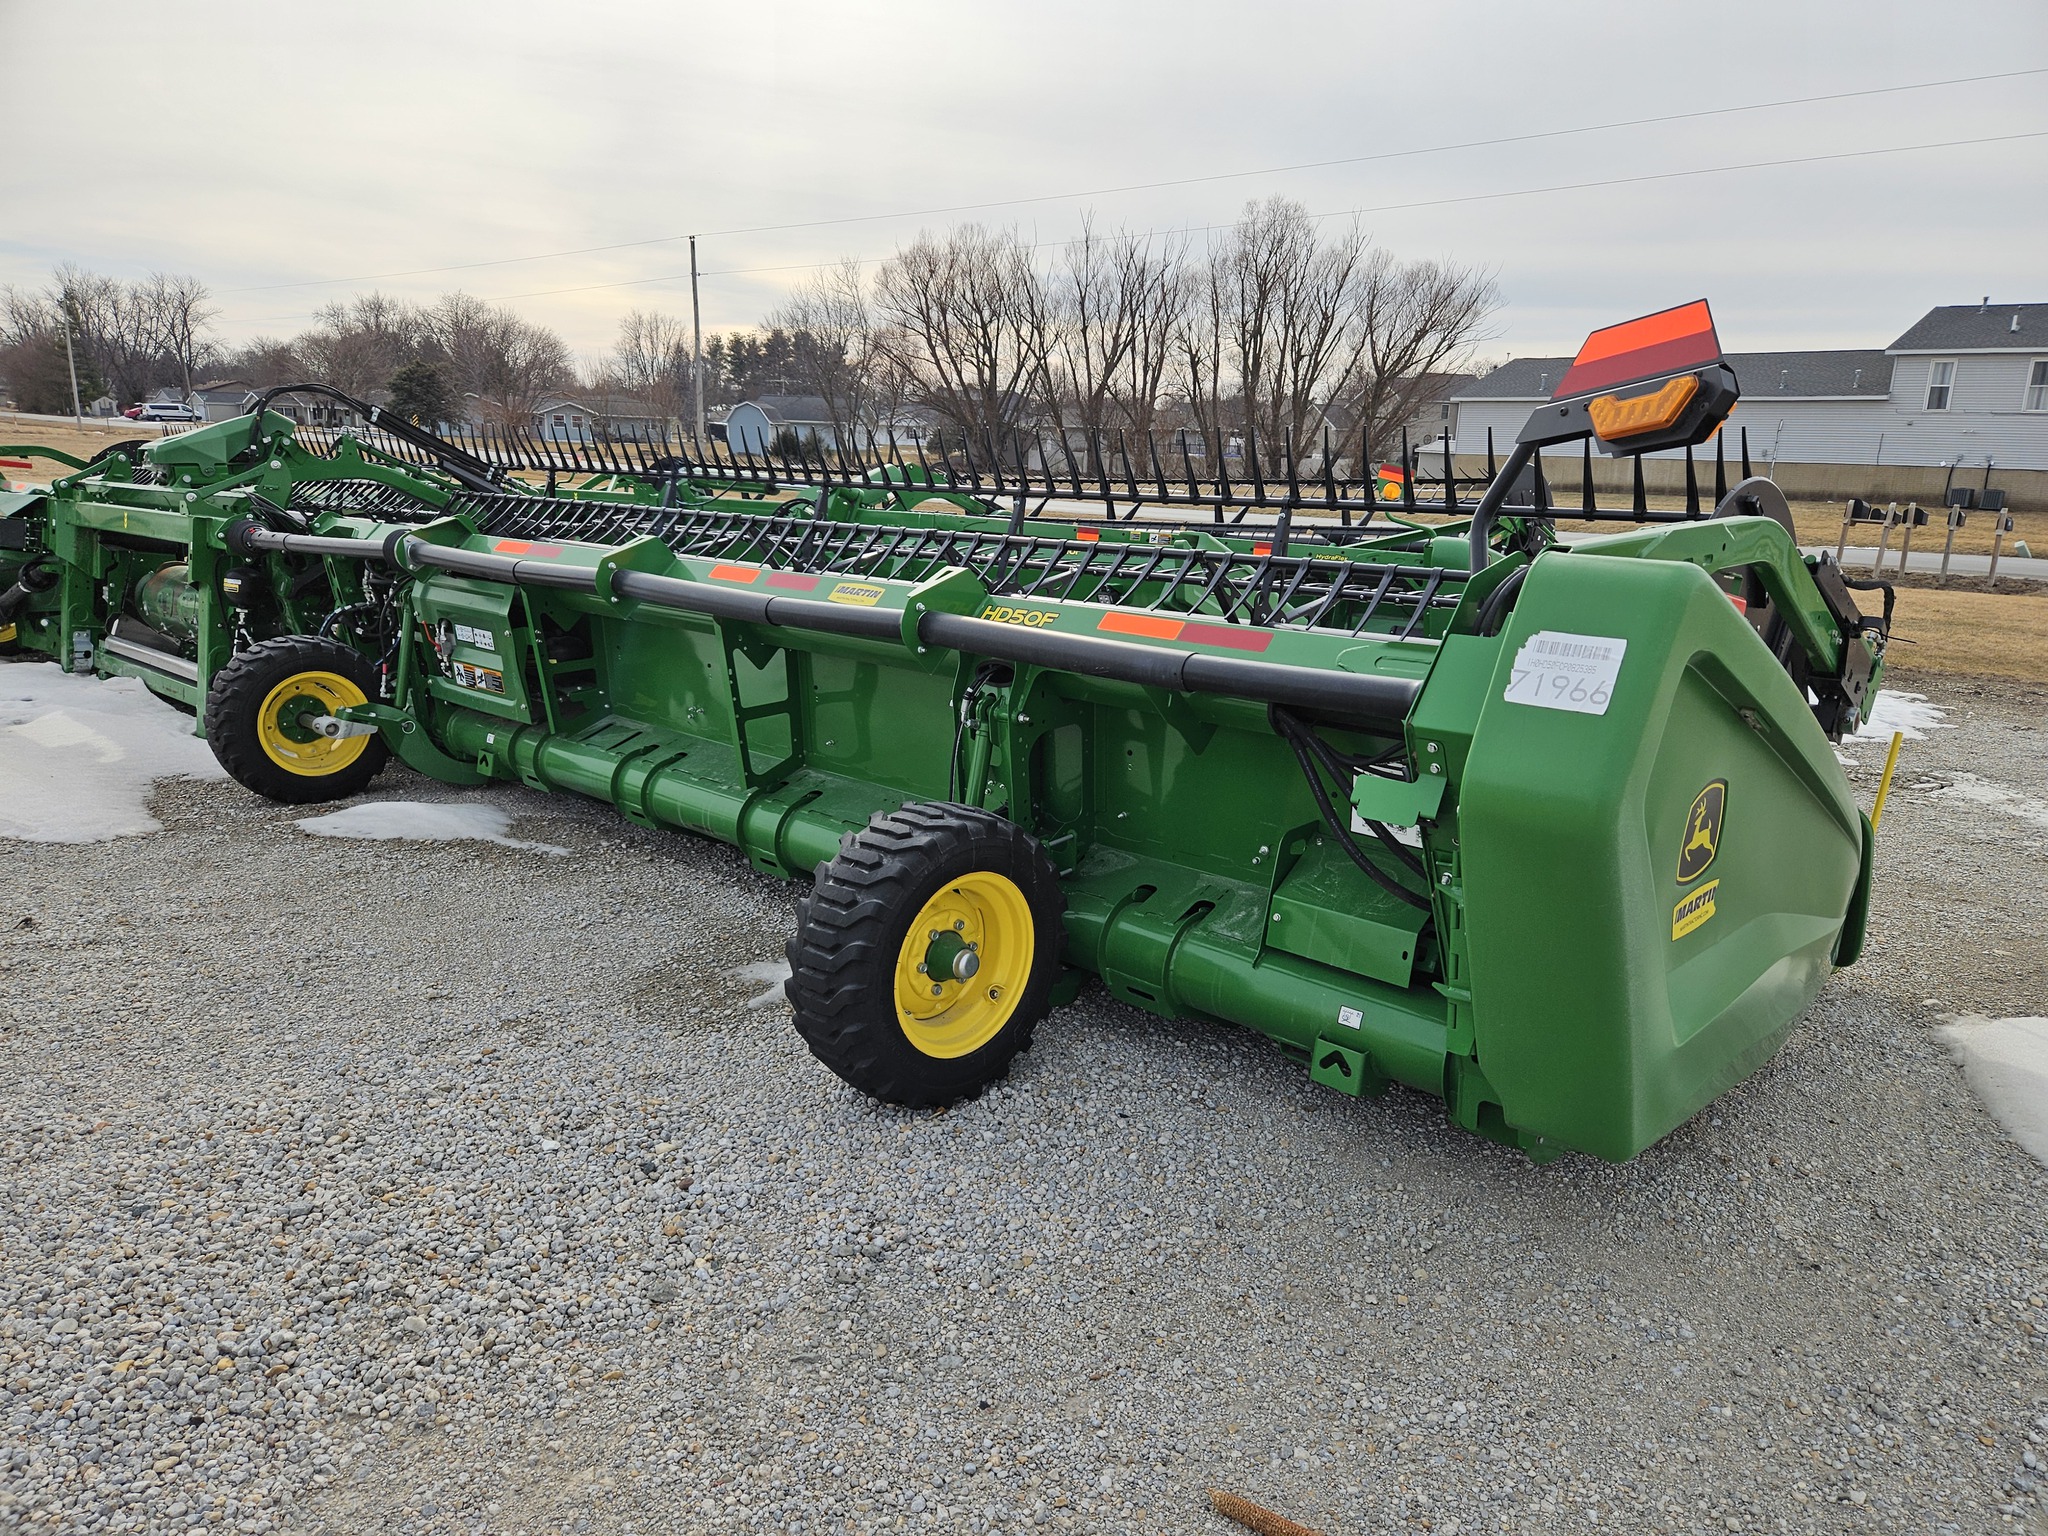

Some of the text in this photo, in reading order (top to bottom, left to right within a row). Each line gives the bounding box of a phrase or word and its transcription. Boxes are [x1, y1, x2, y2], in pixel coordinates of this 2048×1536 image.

[835, 585, 882, 599] MARTIN
[980, 604, 1060, 628] HD50F
[1506, 668, 1609, 705] 71966
